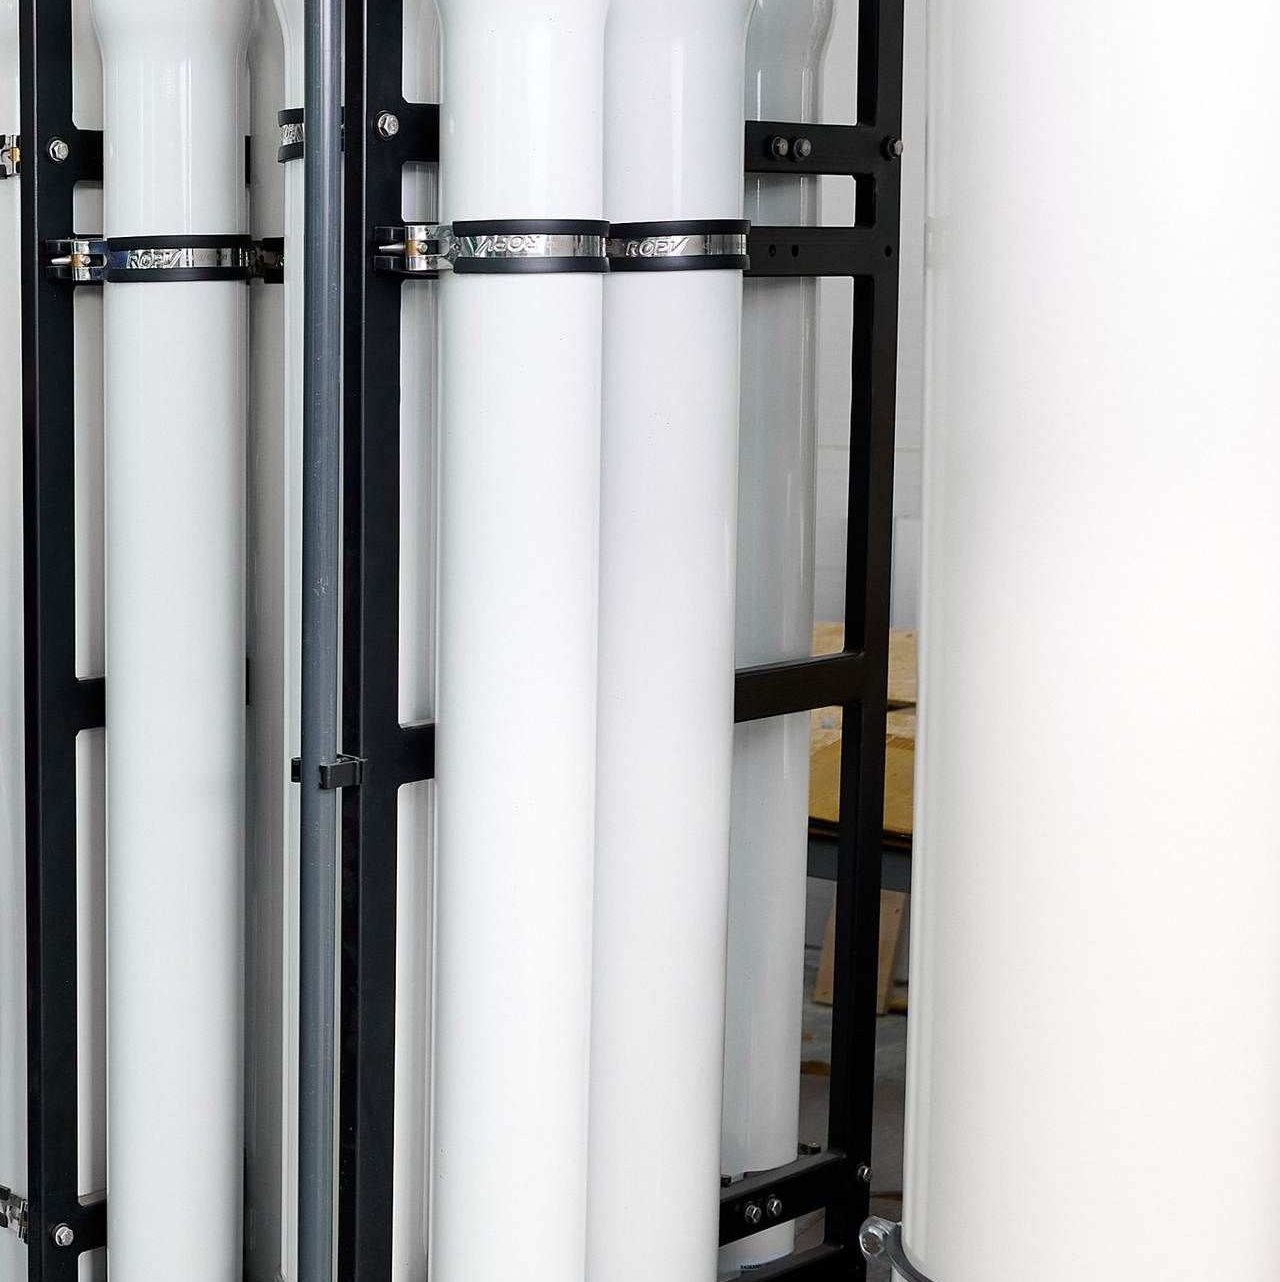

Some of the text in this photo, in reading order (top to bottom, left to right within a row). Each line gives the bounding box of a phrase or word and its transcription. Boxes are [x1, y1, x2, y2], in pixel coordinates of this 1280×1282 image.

[474, 235, 541, 256] ROPV
[625, 235, 690, 257] ROPV
[126, 248, 183, 268] ROPV
